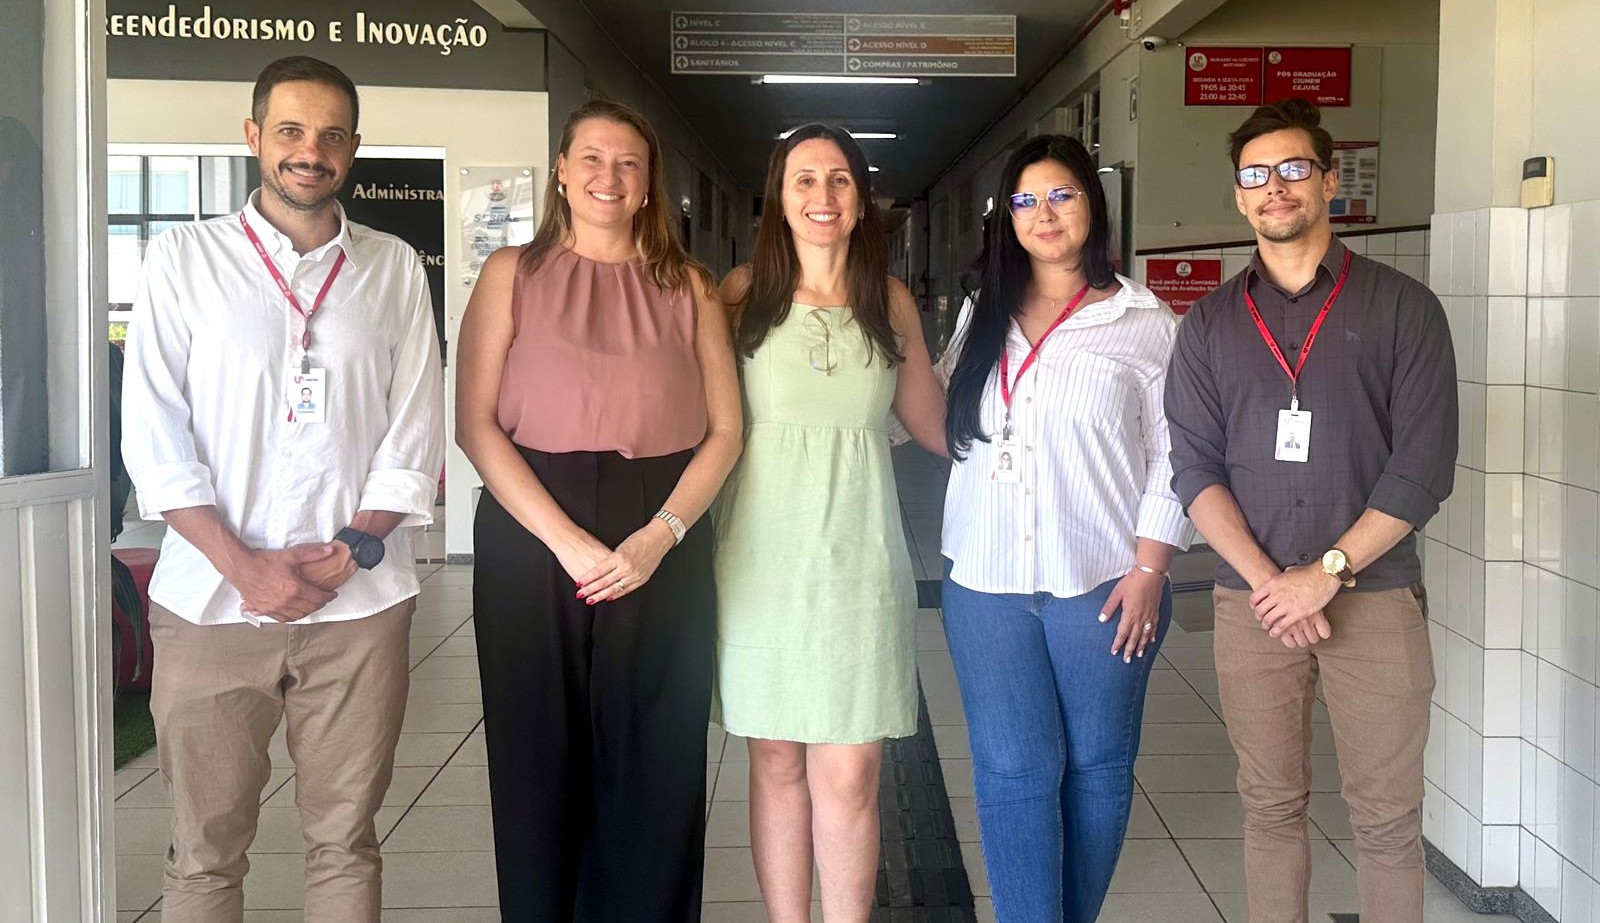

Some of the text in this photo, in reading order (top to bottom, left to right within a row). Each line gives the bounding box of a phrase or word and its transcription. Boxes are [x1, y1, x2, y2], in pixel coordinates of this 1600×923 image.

[862, 40, 894, 49] ACESSO
[862, 59, 902, 69] COMPRAS
[907, 58, 959, 69] PATRIMÔNIO
[1293, 70, 1337, 79] GRADUAÇÃO
